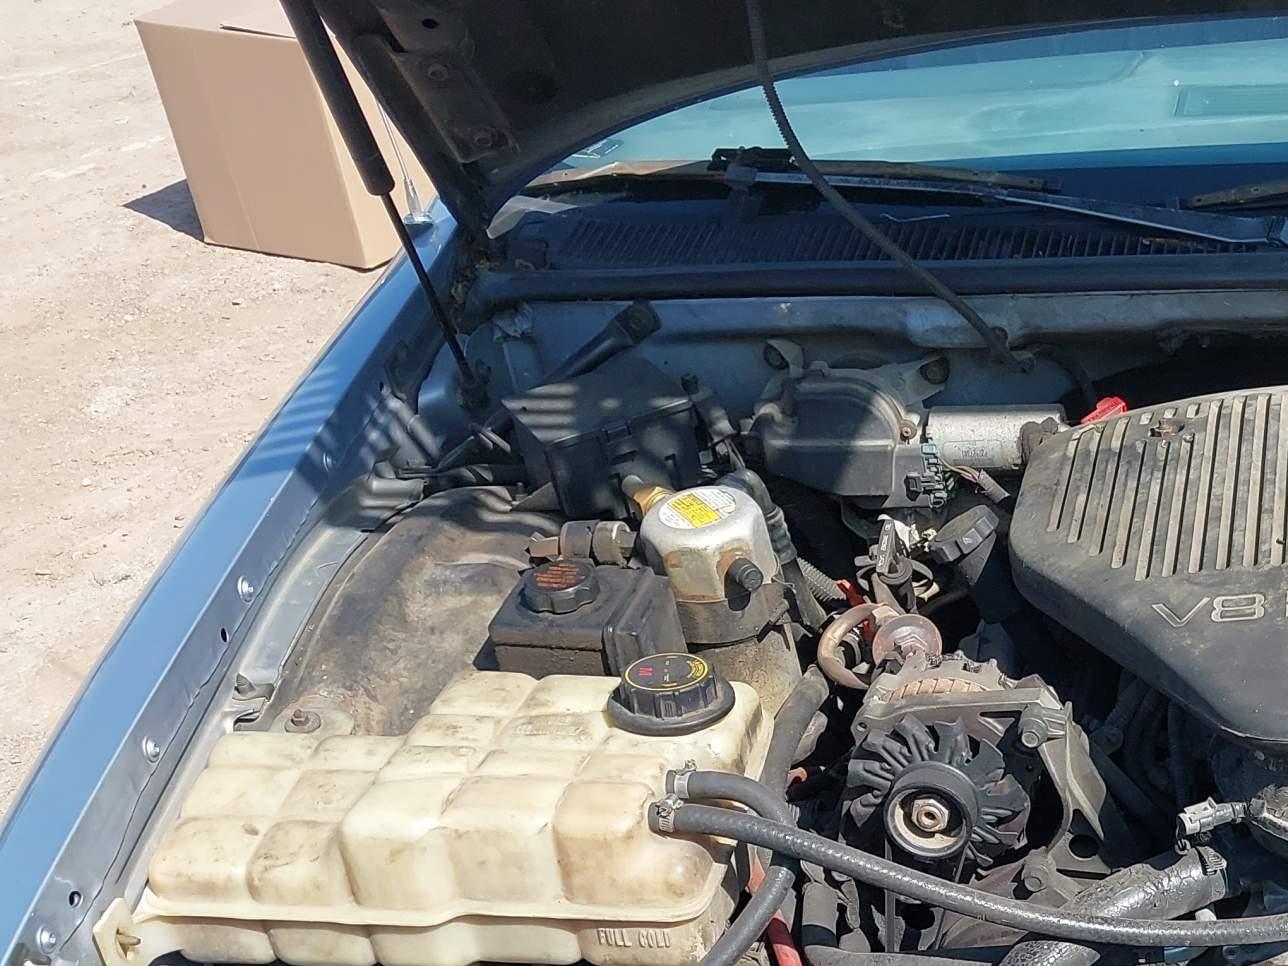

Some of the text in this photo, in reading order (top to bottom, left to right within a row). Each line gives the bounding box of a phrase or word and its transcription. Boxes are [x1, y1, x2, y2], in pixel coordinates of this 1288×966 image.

[1151, 593, 1265, 628] V8
[597, 928, 671, 948] FULL COLD
